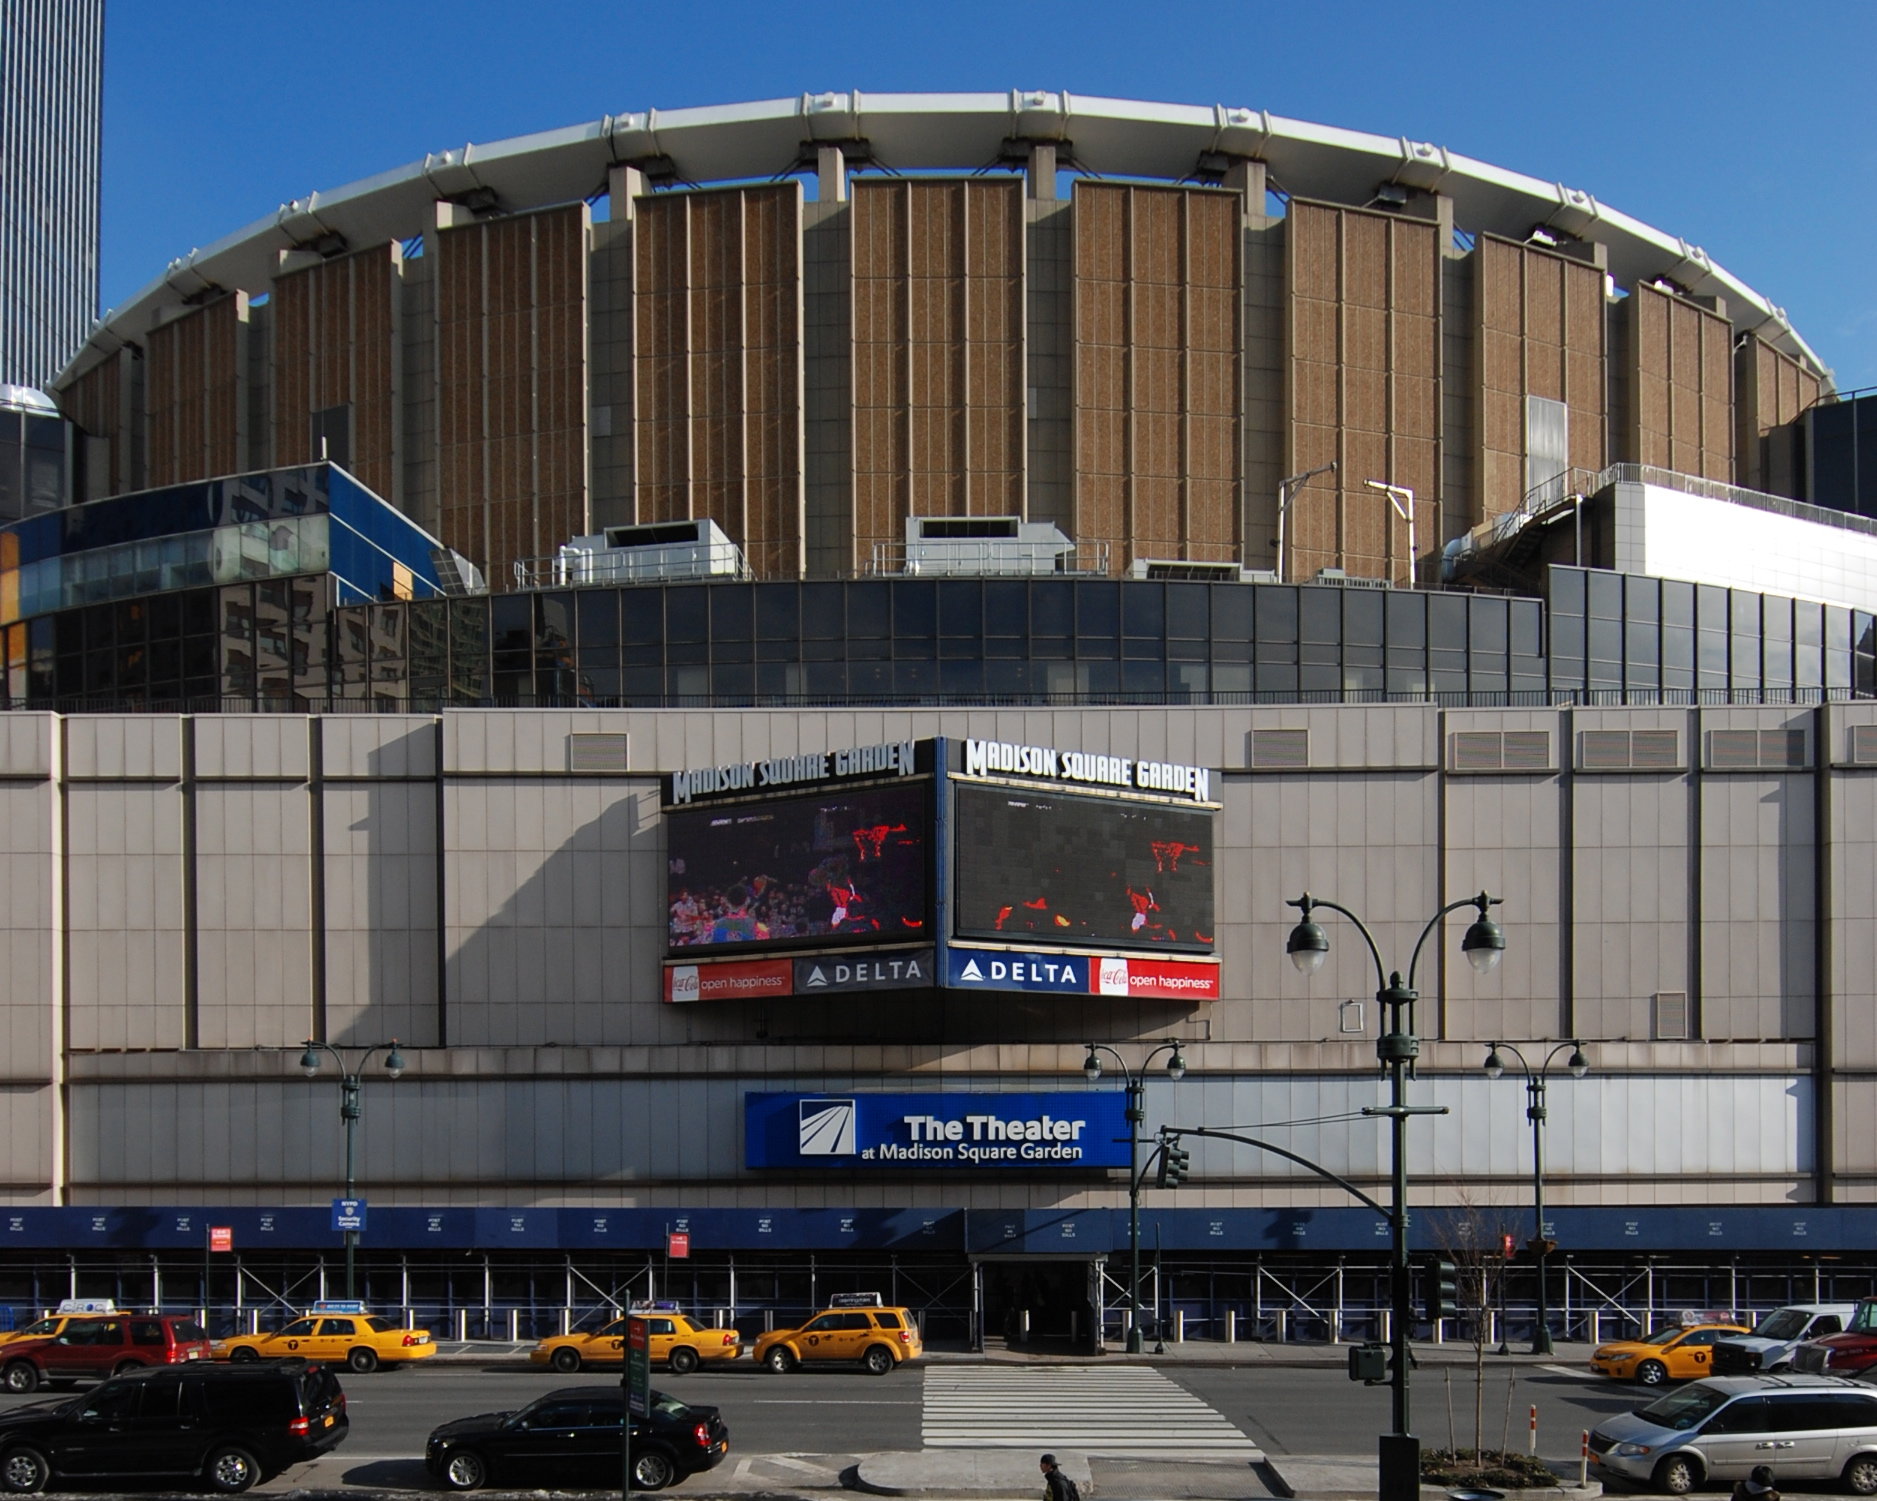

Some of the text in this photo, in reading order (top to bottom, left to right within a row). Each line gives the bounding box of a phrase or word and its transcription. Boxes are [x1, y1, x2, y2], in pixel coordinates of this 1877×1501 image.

[673, 740, 915, 804] MADISON SQUARE GARDEN
[966, 738, 1209, 802] MADISON SQUARE GARDEN
[835, 960, 922, 983] DELTA
[991, 961, 1077, 984] DELTA
[1130, 975, 1156, 988] open
[701, 978, 727, 991] open
[904, 1115, 1086, 1141] The Theater
[861, 1142, 1083, 1164] at Madison Square Garden
